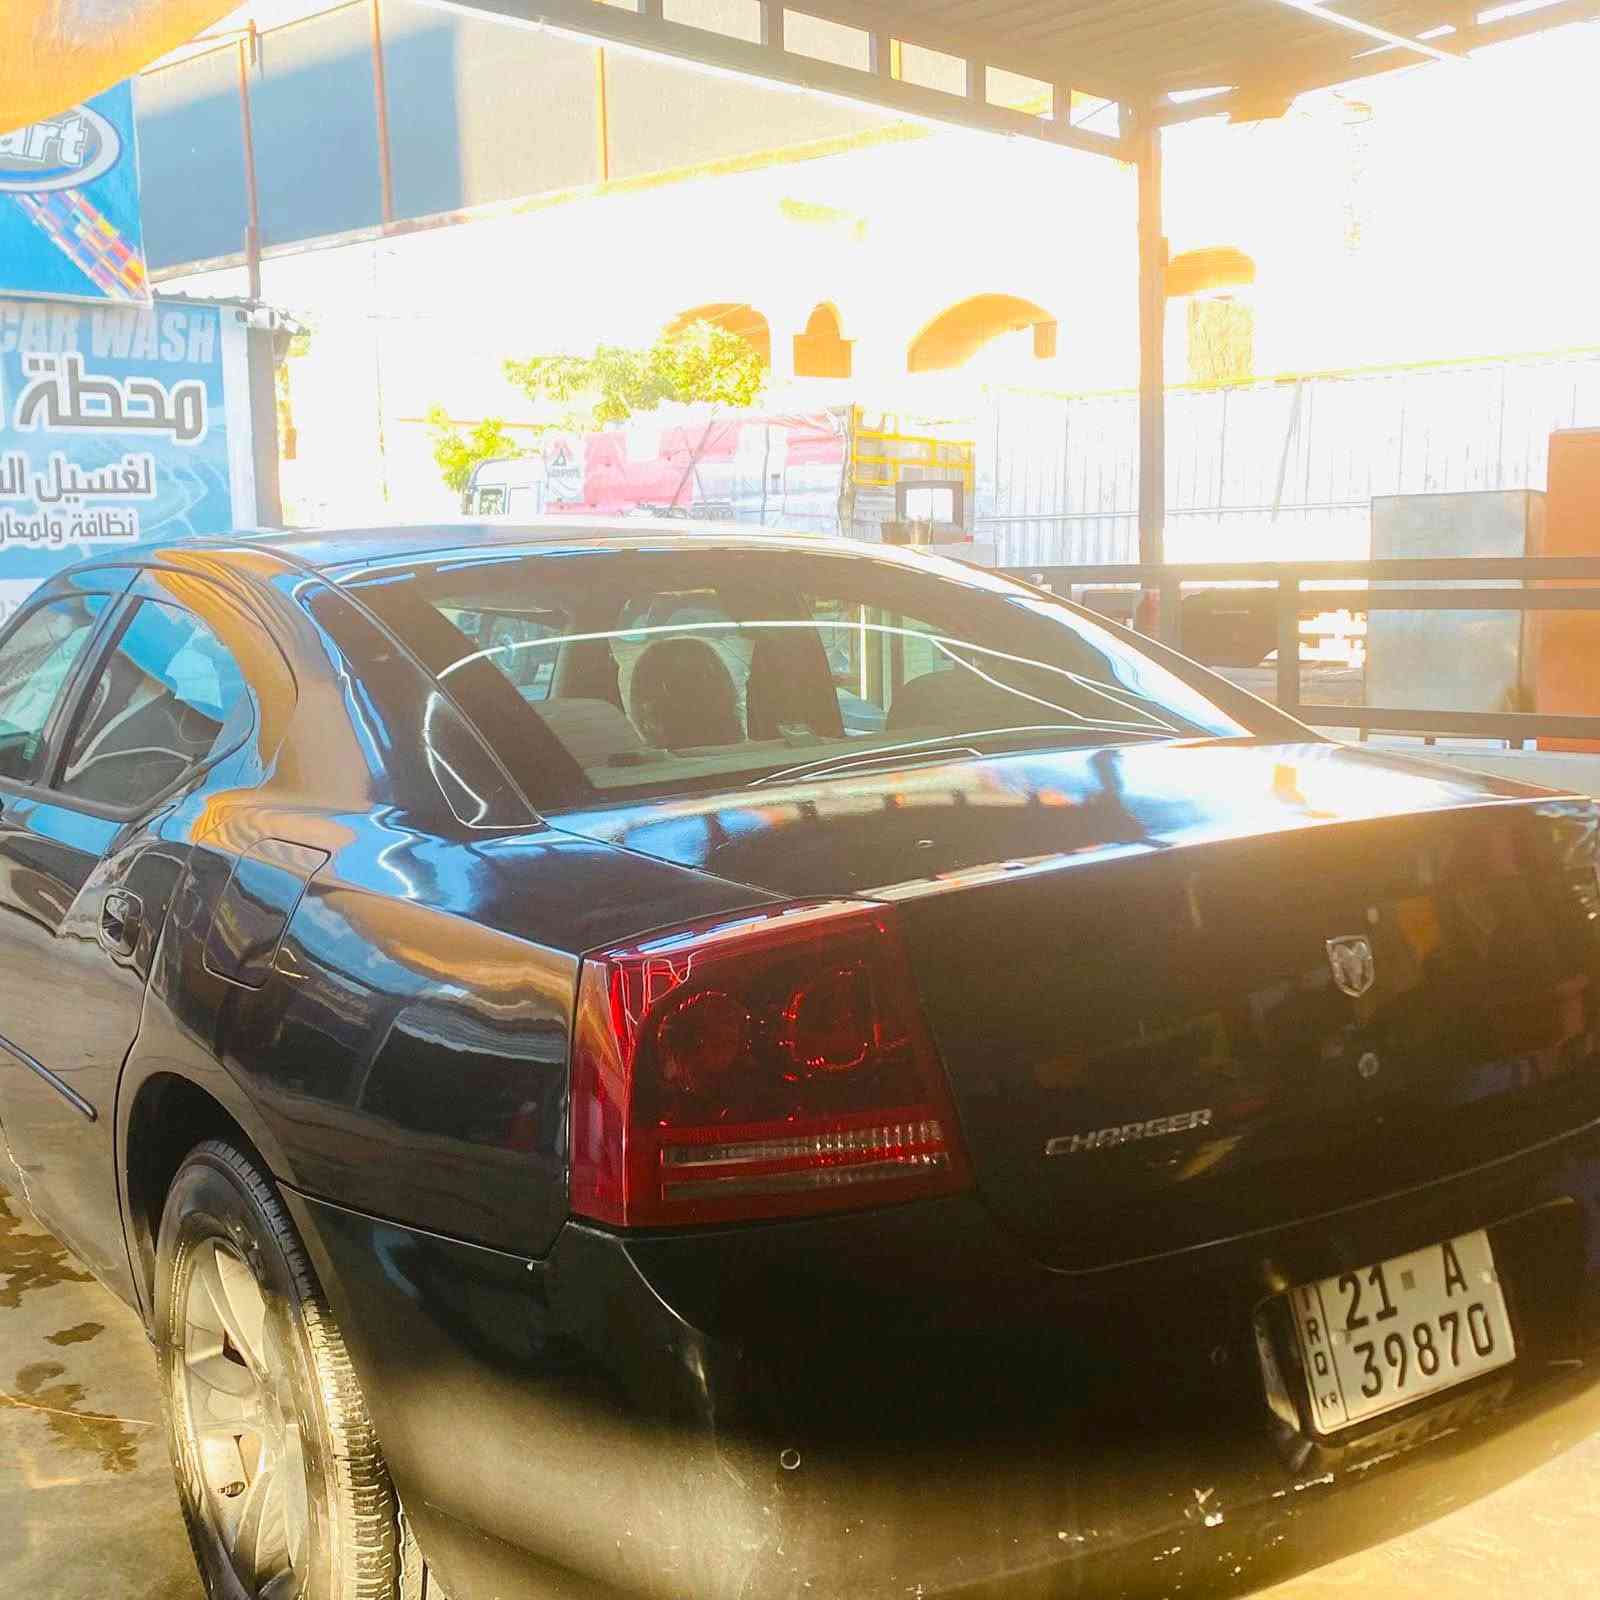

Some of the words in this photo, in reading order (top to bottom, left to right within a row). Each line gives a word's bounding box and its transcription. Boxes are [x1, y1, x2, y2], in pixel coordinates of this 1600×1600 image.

[91, 307, 215, 363] WASH
[18, 354, 204, 442] محطة
[35, 457, 153, 504] لغسيل
[69, 512, 135, 538] نظافة
[1045, 1108, 1213, 1155] CHARGER
[1338, 1265, 1398, 1331] 21
[1441, 1243, 1469, 1297] A
[1353, 1302, 1495, 1399] 39870
